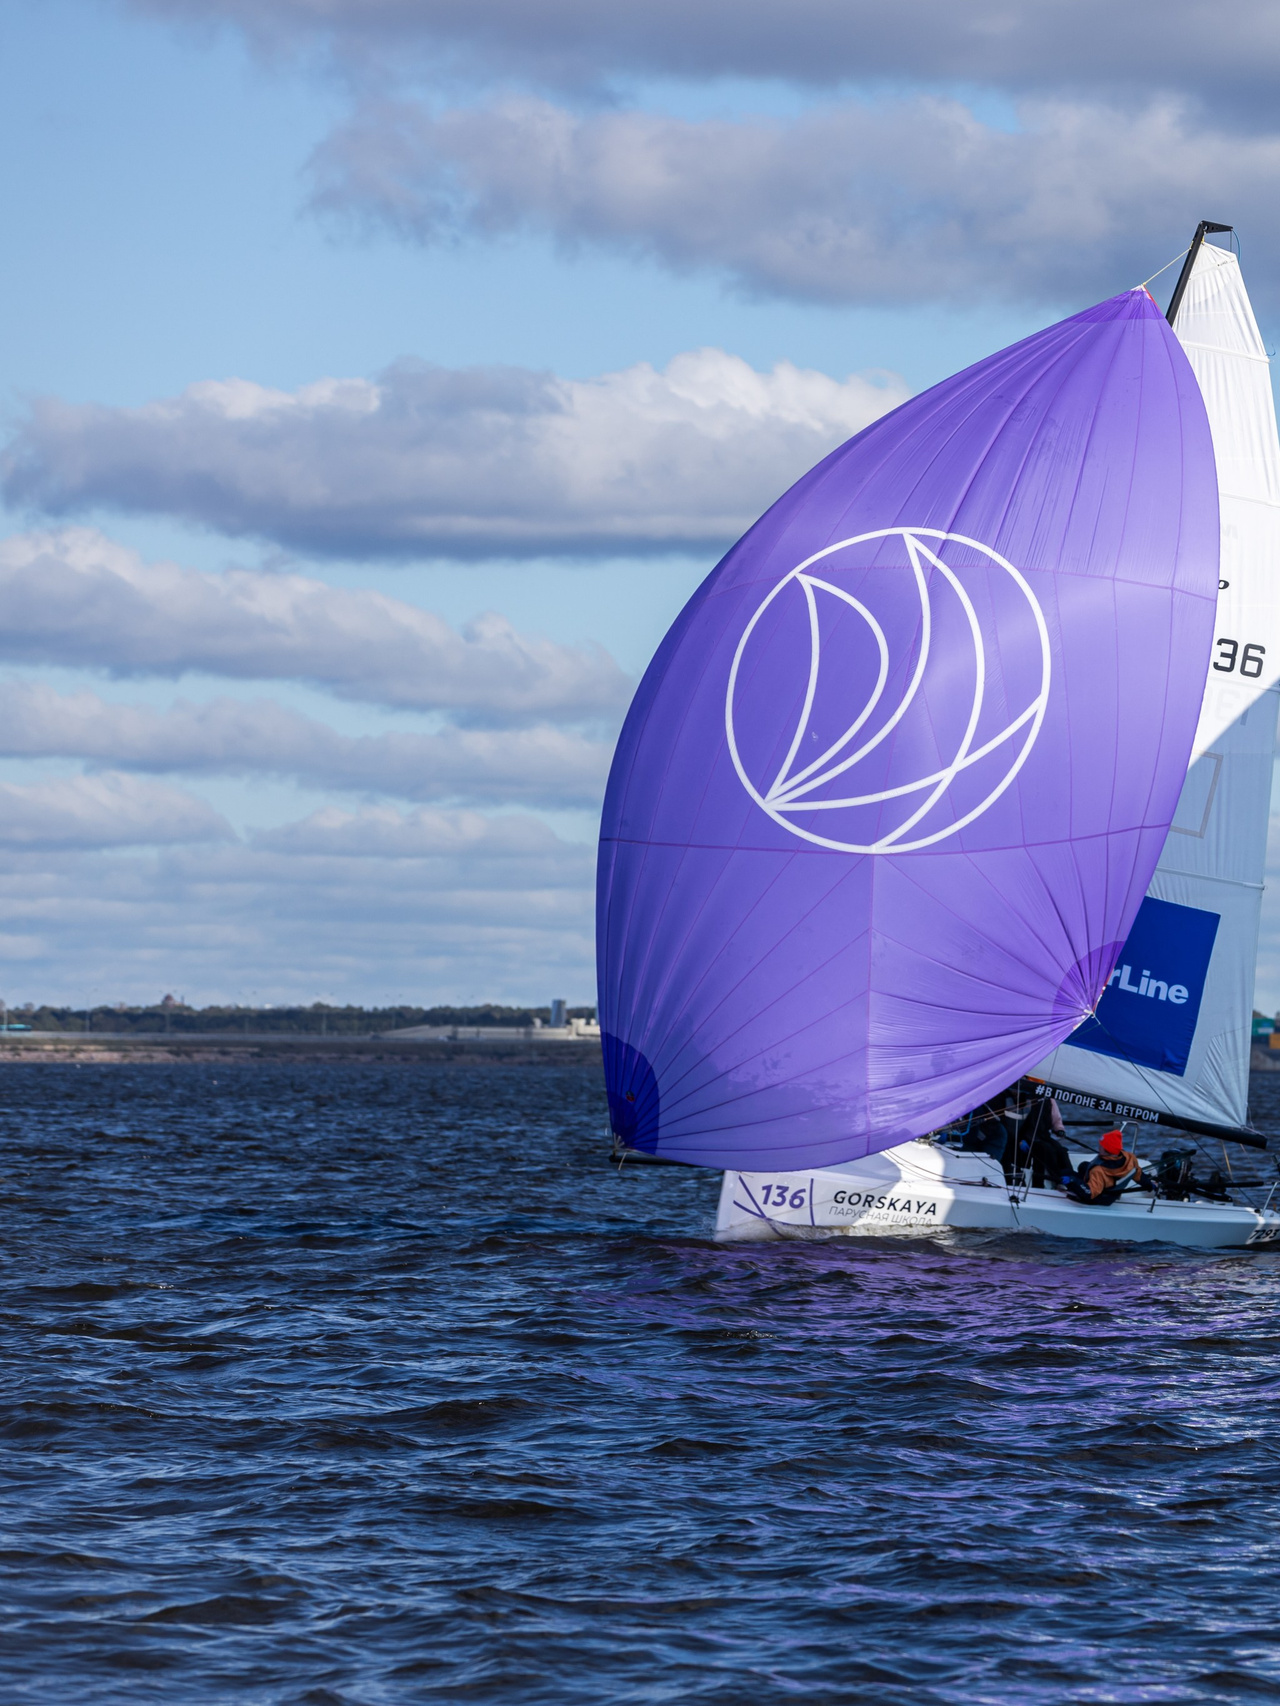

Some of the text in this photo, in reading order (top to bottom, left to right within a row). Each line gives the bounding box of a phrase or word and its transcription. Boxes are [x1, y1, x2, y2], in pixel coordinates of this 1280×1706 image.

[1213, 638, 1266, 678] 36
[1054, 1089, 1097, 1109] ПОГОНЕ
[1098, 1100, 1113, 1113] ЗА
[1115, 1103, 1159, 1123] ВЕТРОМ
[761, 1184, 806, 1209] 136
[833, 1190, 937, 1216] GORSKAYA
[829, 1206, 890, 1221] ПАРУСНАЯ
[1249, 1228, 1280, 1240] 7293
